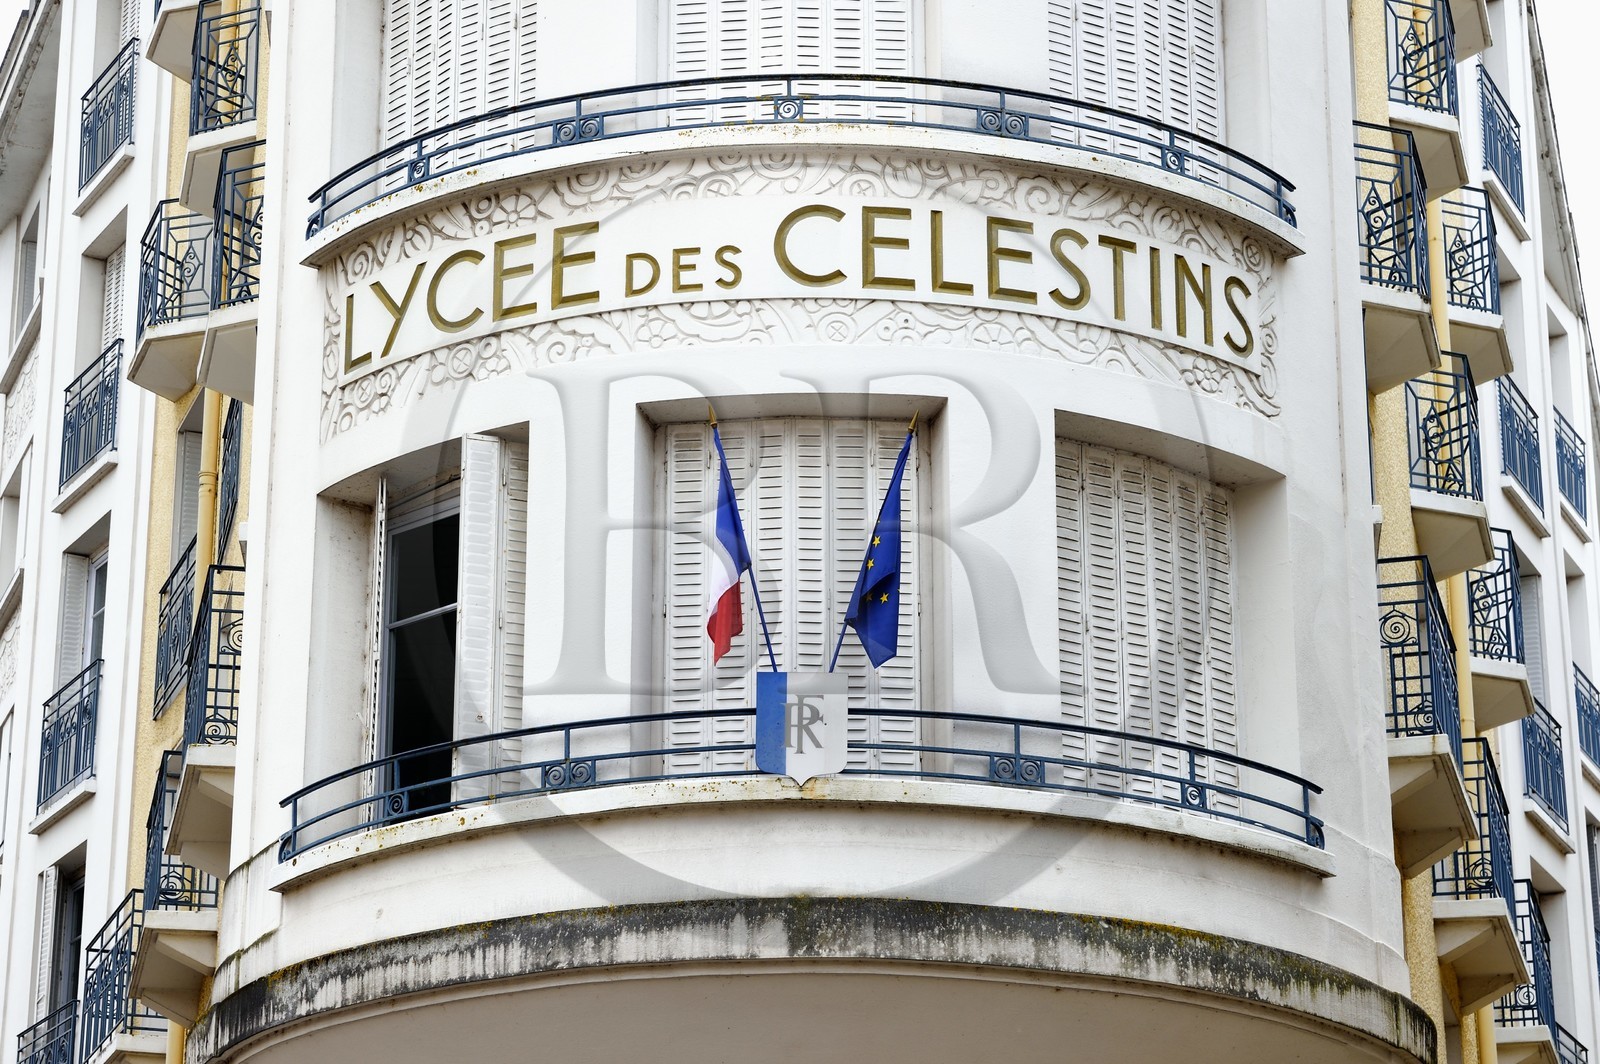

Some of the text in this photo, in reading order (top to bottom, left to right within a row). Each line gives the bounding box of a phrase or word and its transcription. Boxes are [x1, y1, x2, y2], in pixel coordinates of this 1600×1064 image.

[343, 203, 1254, 375] LYCEE DES CELESTINS
